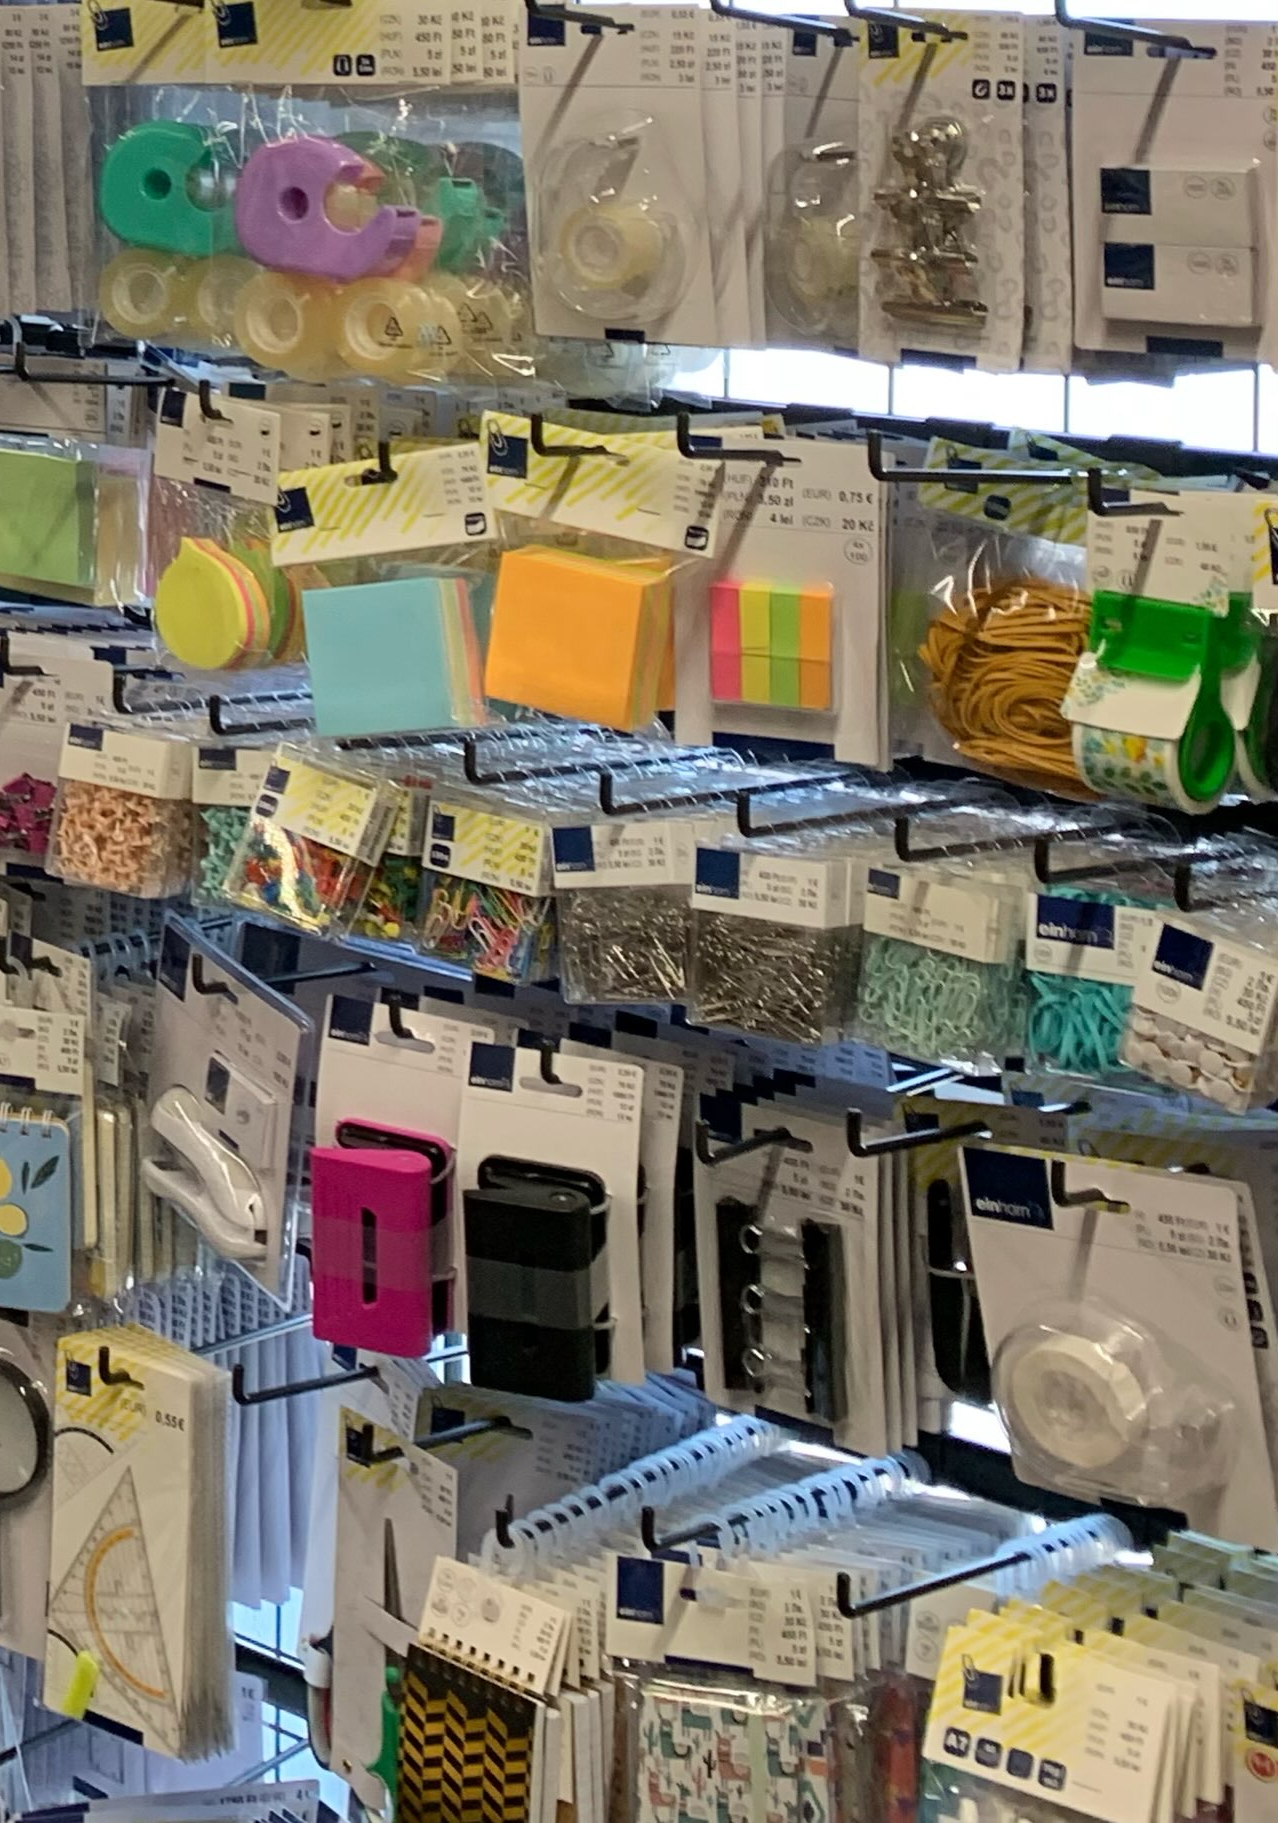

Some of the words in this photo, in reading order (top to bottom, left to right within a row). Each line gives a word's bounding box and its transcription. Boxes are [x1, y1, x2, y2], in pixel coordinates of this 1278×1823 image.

[838, 489, 864, 505] 0,75
[865, 491, 874, 506] €
[841, 517, 856, 531] 20
